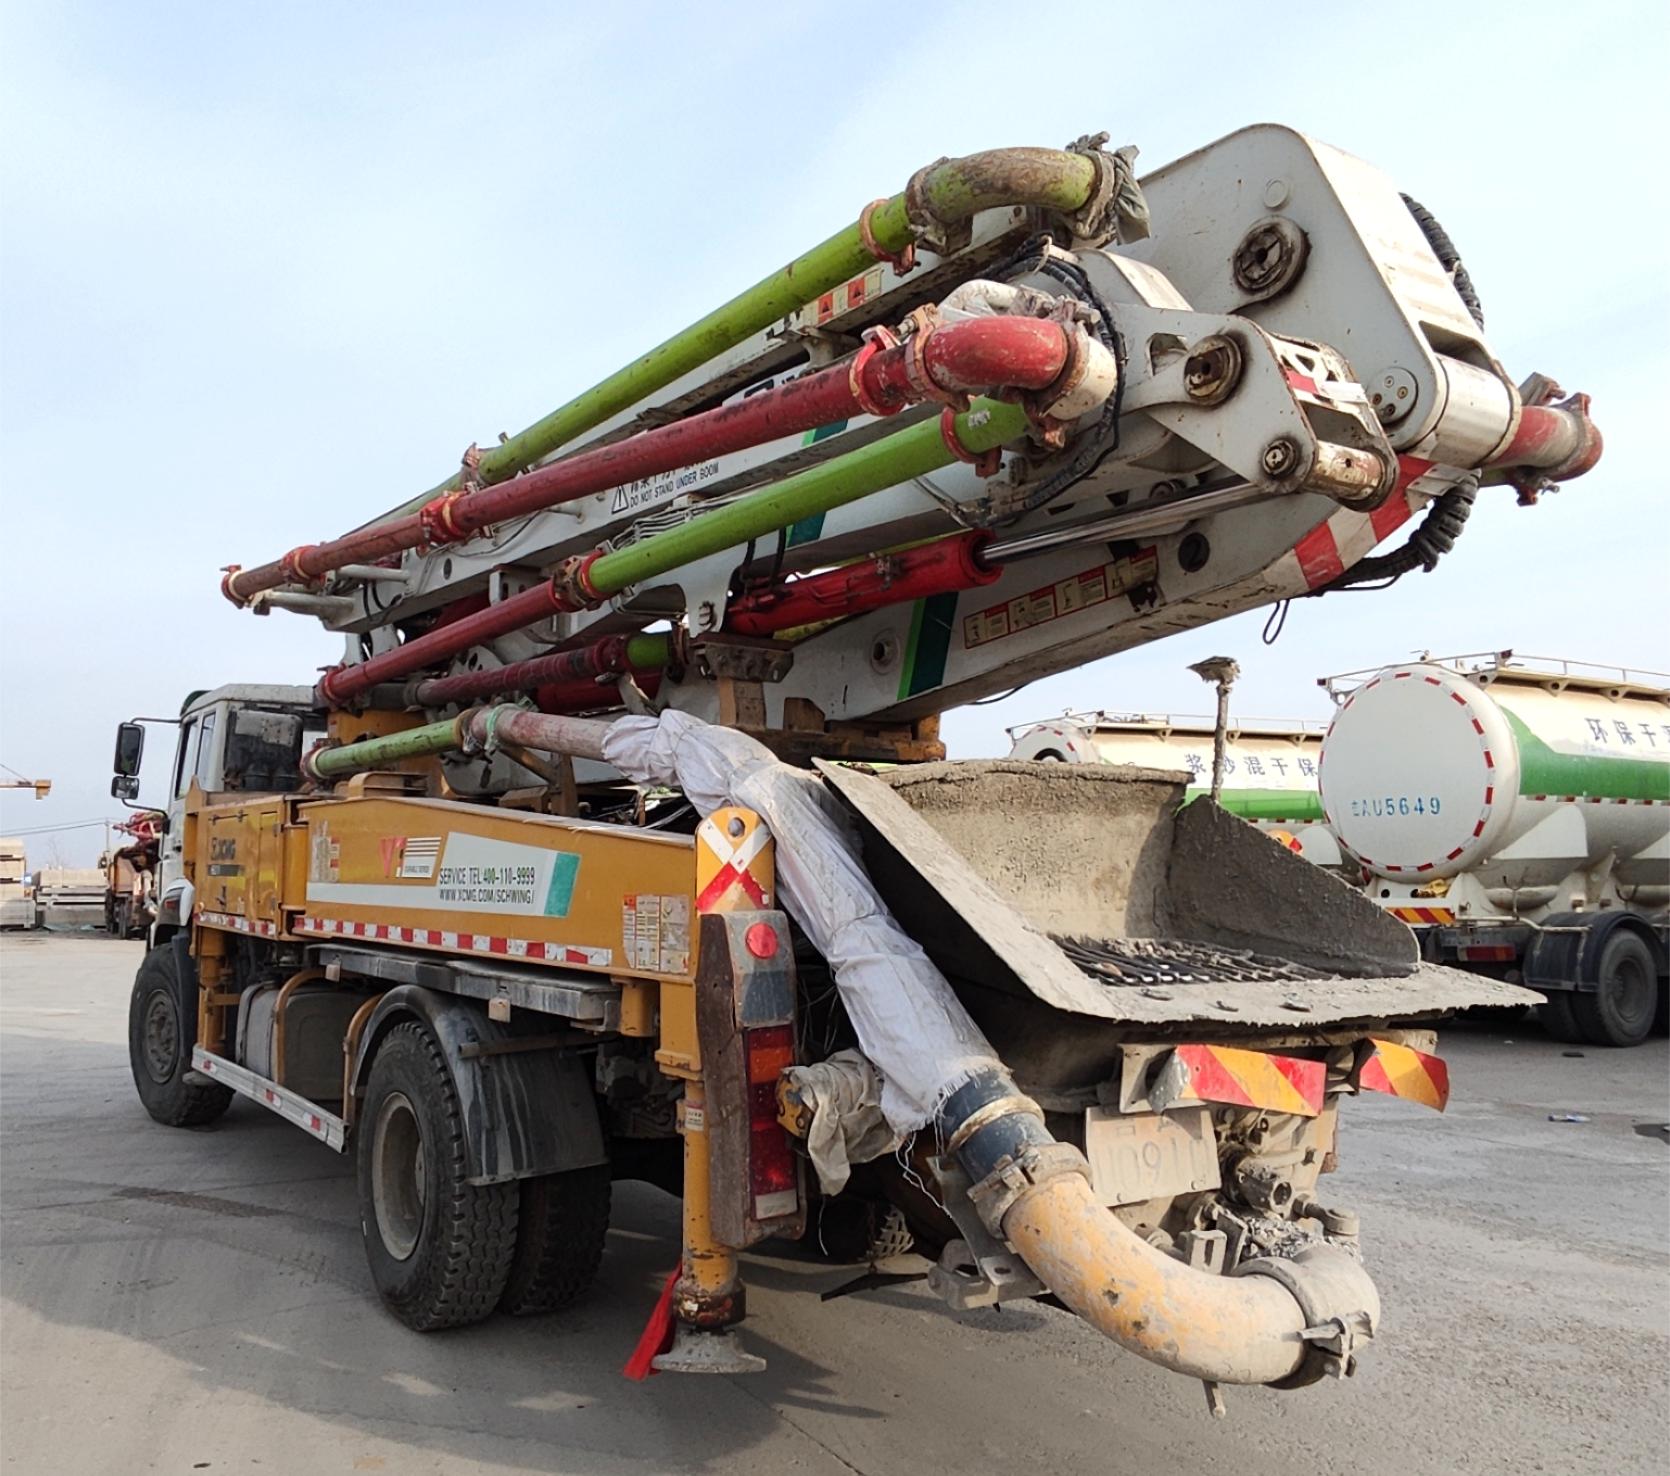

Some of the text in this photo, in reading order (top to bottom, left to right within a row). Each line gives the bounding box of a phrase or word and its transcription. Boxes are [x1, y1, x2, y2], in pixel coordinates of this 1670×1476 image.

[631, 495, 638, 508] DO
[641, 490, 652, 502] NOT
[655, 481, 673, 498] STAND
[676, 471, 697, 489] UNDER
[700, 462, 719, 479] BOOM
[440, 867, 465, 884] SERVICE
